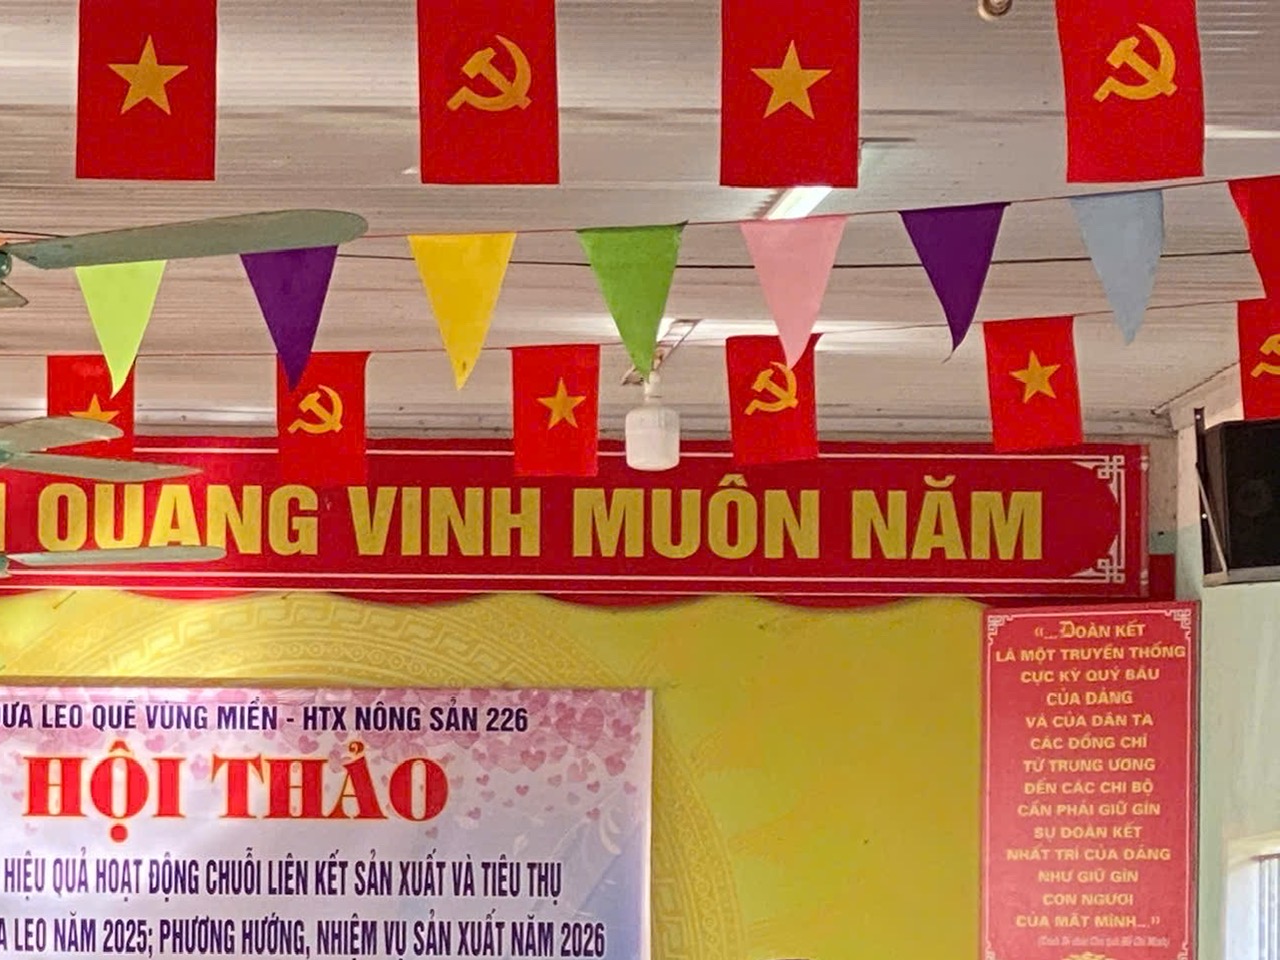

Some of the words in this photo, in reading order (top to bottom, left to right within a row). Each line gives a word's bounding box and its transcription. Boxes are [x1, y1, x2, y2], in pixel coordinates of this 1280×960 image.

[37, 483, 320, 556] QUANG
[346, 486, 542, 558] VINH
[573, 473, 820, 560] MUÔN
[850, 474, 1045, 561] NĂM
[1115, 621, 1145, 637] KẾT
[1021, 646, 1056, 665] MỘT
[41, 704, 83, 729] LEO
[92, 699, 137, 731] QUÊ
[145, 700, 208, 731] VÙNG
[217, 697, 278, 731] MIỀN
[303, 706, 347, 732] HTX
[355, 701, 420, 732] NÔNG
[430, 696, 478, 732] SẢN
[486, 707, 529, 732] 226
[1049, 759, 1103, 772] TRUNG
[1108, 758, 1155, 771] ƯƠNG
[22, 739, 186, 843] HỘI
[211, 741, 449, 822] THẢO
[1100, 781, 1127, 793] CHI
[4, 850, 46, 900] HIỆU
[53, 847, 89, 896] QUẢ
[96, 858, 143, 902] HOẠT
[148, 851, 199, 902] ĐỘNG
[205, 847, 261, 896] CHUỖI
[267, 854, 308, 896] LIÊN
[314, 849, 349, 896] KẾT
[355, 849, 392, 897] SẢN
[399, 849, 446, 897] XUẤT
[452, 855, 476, 897] VÀ
[482, 855, 520, 897] TIÊU
[527, 862, 562, 905] THỤ
[1038, 870, 1074, 882] NHƯ
[1042, 893, 1077, 906] CON
[14, 917, 47, 951] LEO
[54, 911, 96, 952] NĂM
[103, 918, 154, 958] 2025;
[159, 915, 235, 954] PHƯƠNG
[242, 912, 311, 959] HƯỚNG,
[413, 908, 452, 956] SẢN
[457, 908, 505, 957] XUẤT
[511, 914, 554, 957] NĂM
[560, 922, 605, 958] 2026
